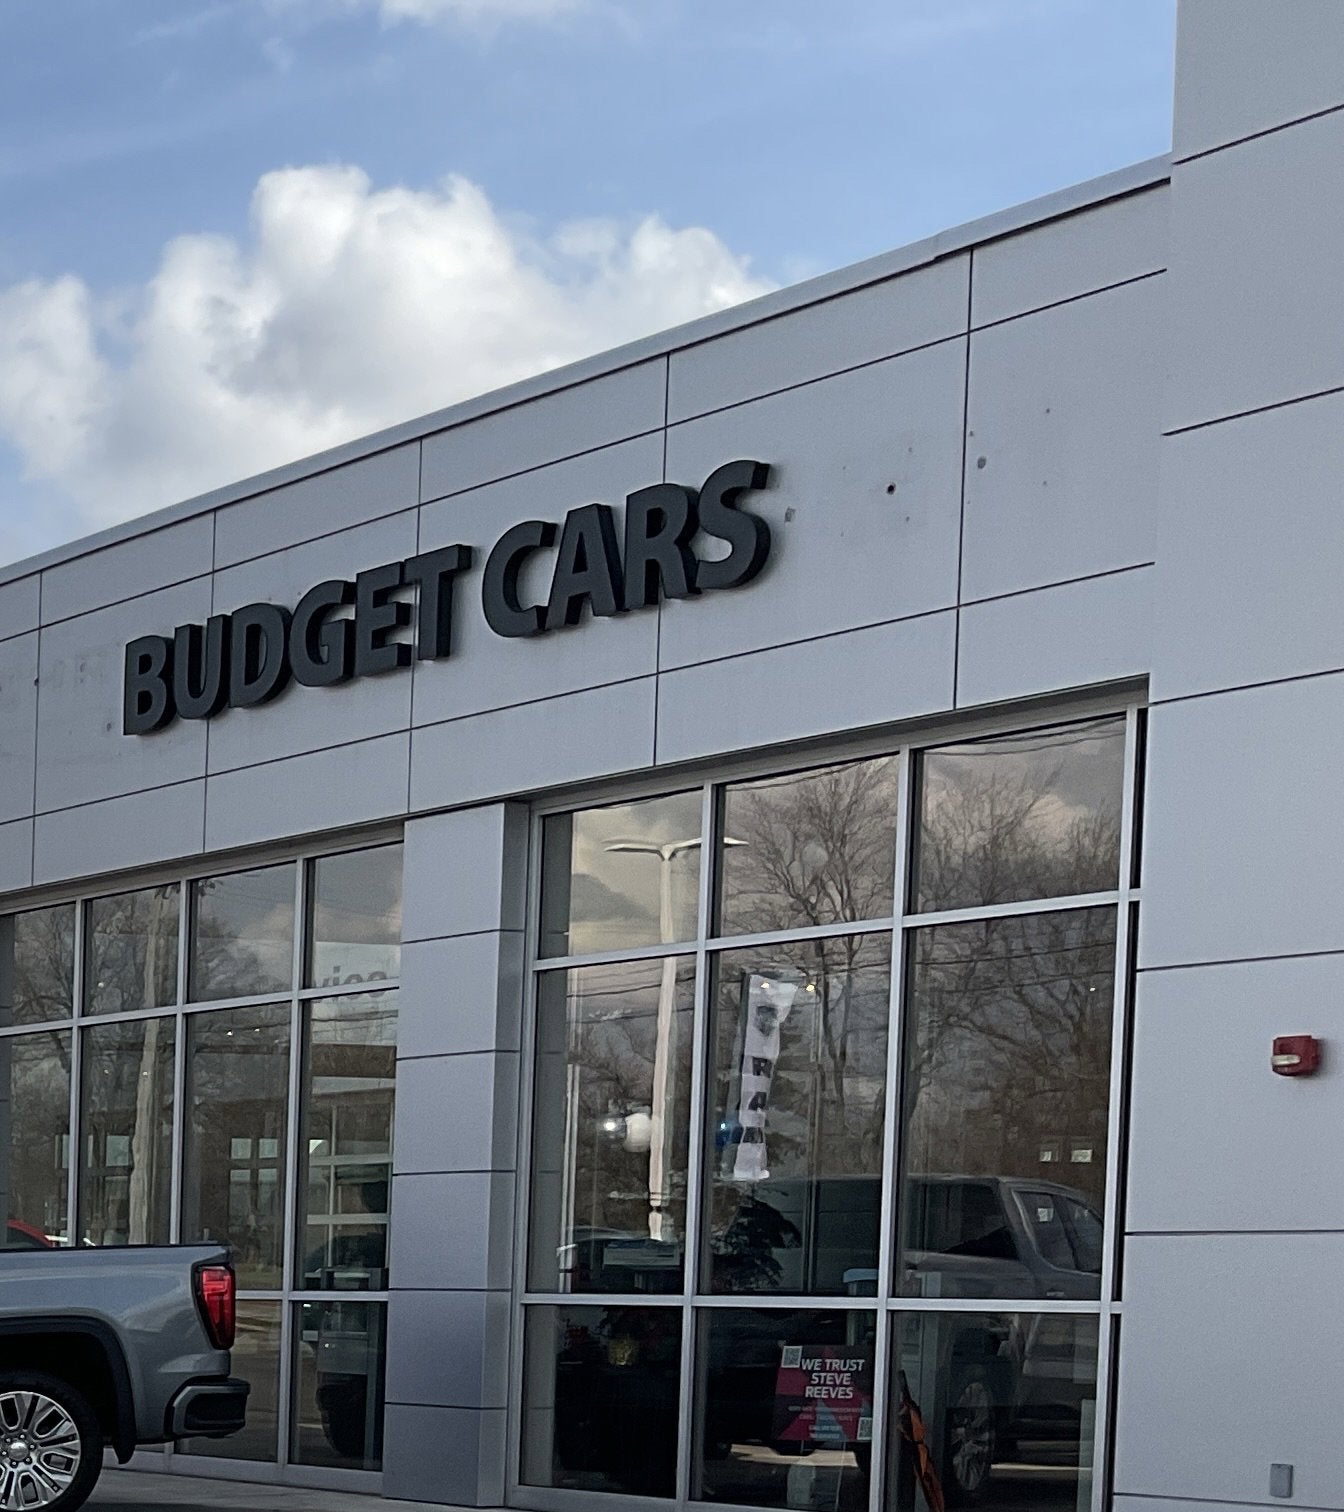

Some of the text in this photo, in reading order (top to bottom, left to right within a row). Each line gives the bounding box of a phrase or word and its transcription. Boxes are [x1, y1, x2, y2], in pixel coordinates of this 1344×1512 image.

[123, 459, 771, 736] BUDGET CARS
[801, 1359, 865, 1371] WE TRUST
[810, 1372, 852, 1385] STEVE
[805, 1385, 854, 1399] REEVES
